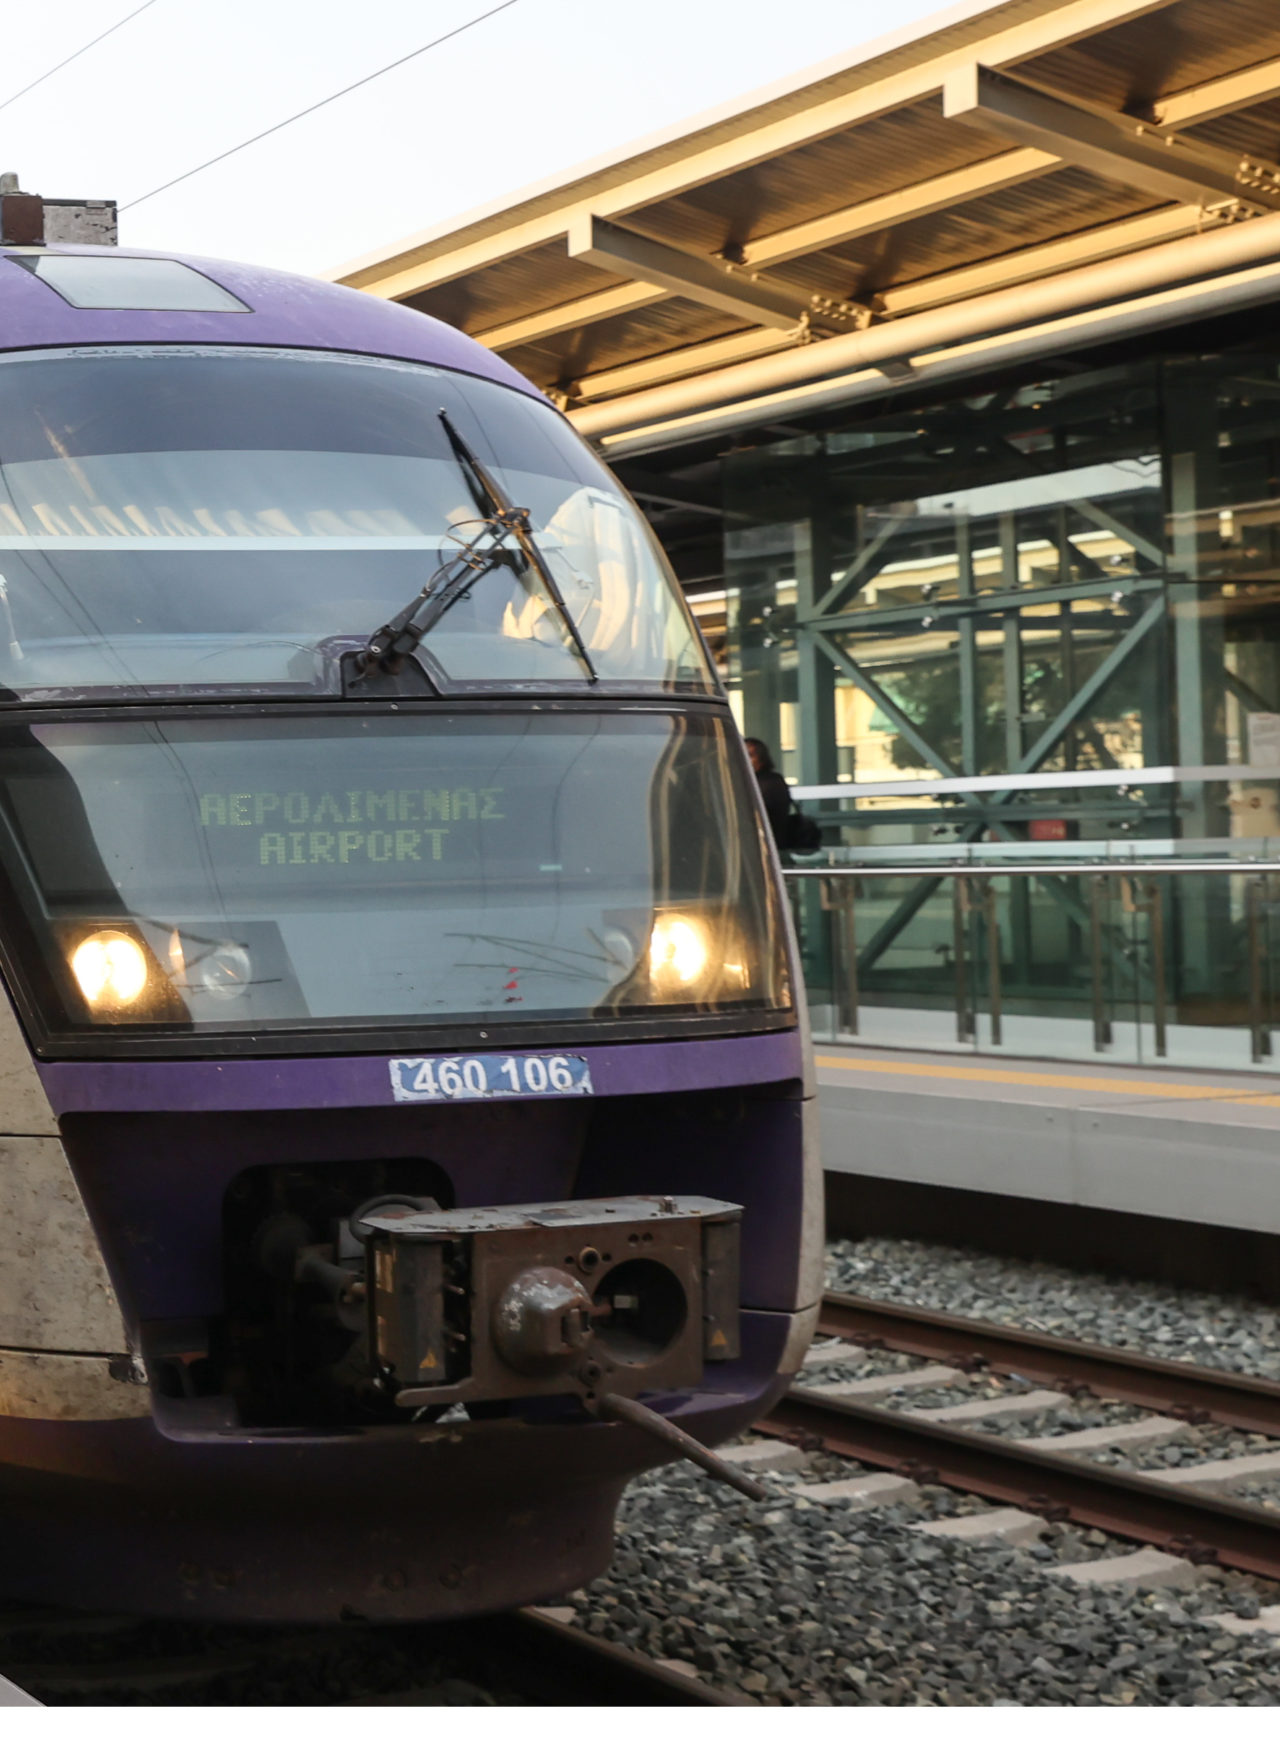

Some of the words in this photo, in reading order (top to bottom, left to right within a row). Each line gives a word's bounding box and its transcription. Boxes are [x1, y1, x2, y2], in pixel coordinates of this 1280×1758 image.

[200, 787, 505, 826] ΑΕΡΟΛΙΜΕΝΑΣ
[259, 828, 451, 865] AIRPORT
[413, 1059, 487, 1099] 460
[501, 1057, 573, 1093] 106
